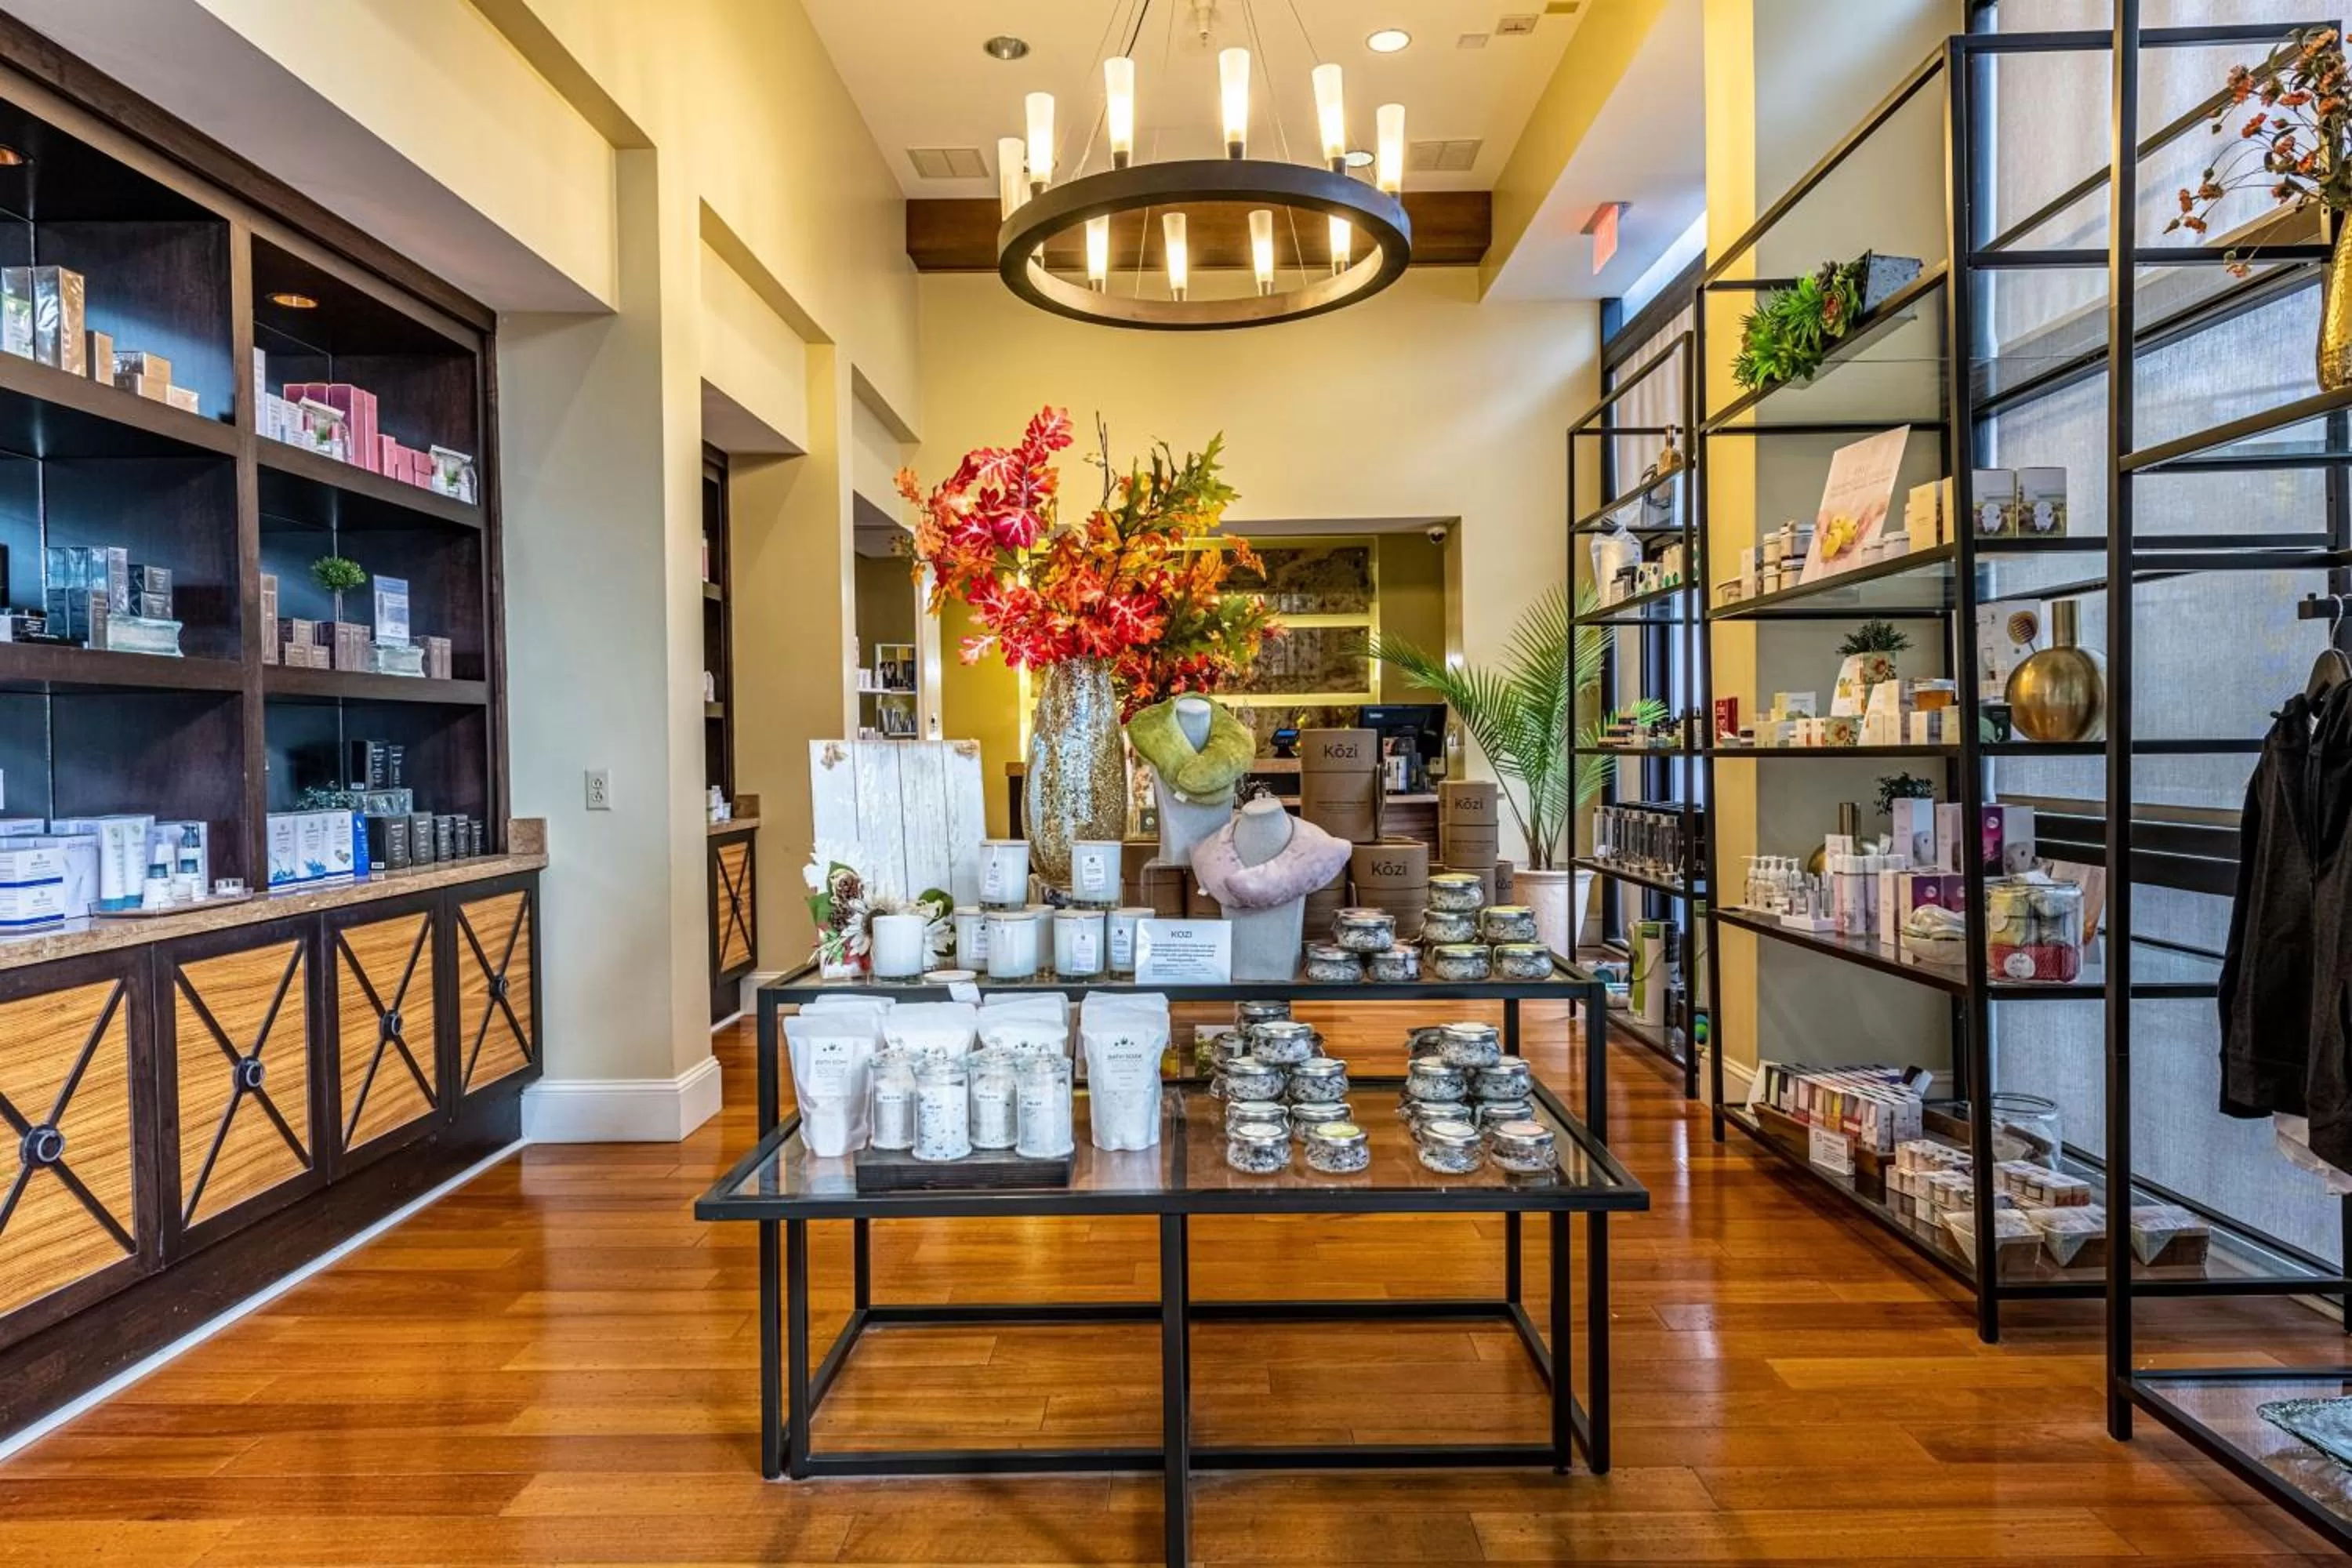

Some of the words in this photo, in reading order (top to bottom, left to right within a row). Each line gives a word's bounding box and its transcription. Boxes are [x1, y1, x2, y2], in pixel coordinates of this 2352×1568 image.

[1324, 743, 1358, 758] Kōzi
[1454, 797, 1483, 810] Kōzi
[1371, 861, 1407, 876] Kōzi
